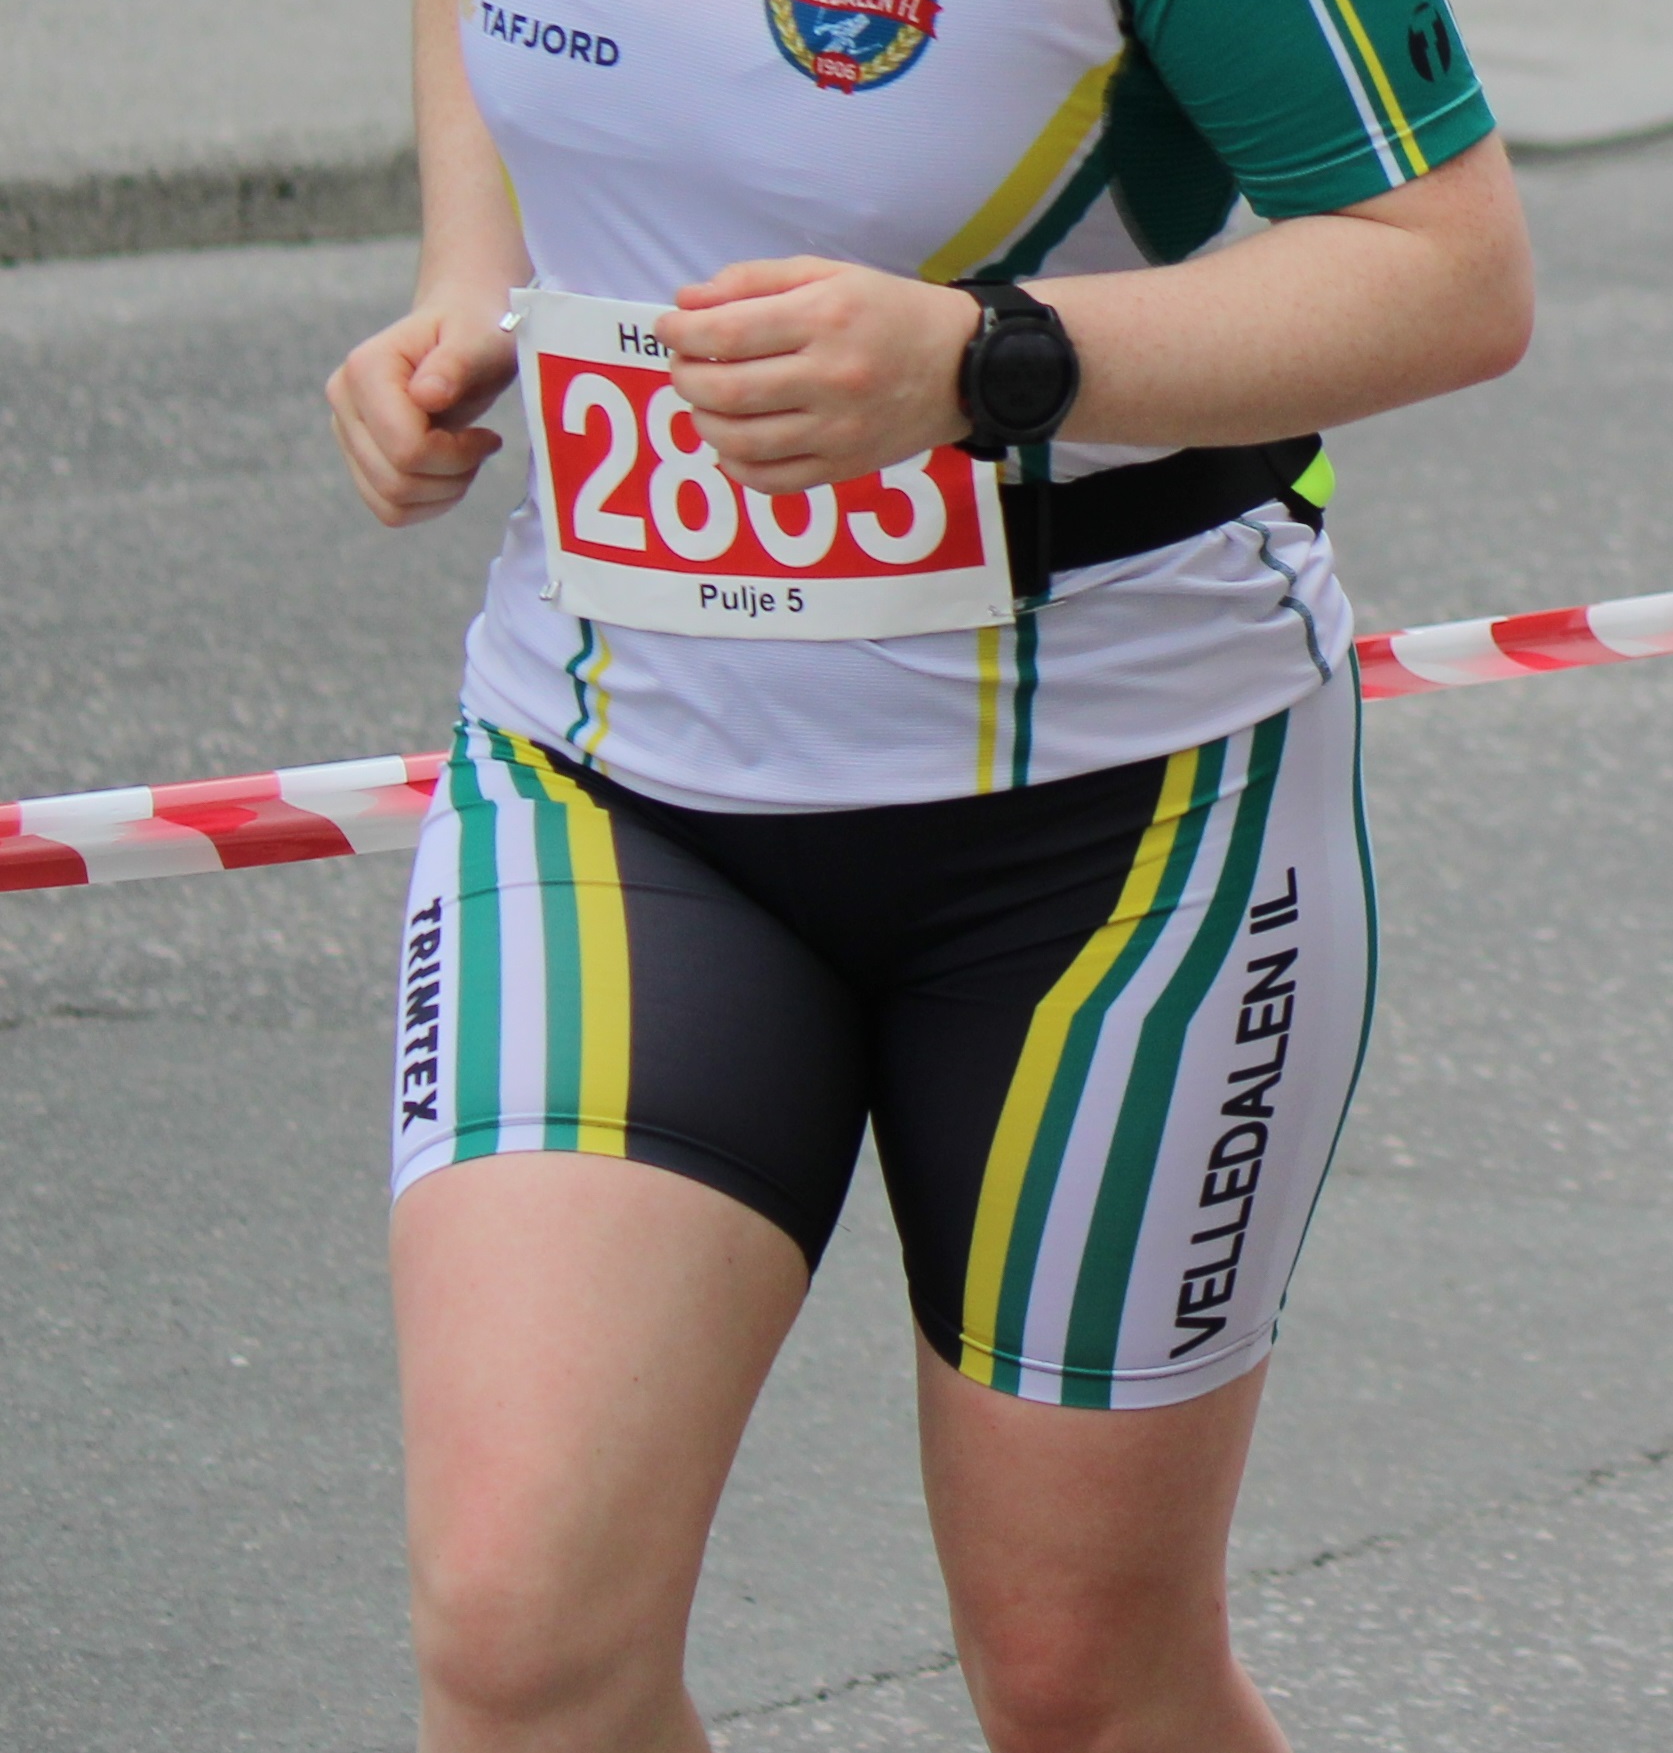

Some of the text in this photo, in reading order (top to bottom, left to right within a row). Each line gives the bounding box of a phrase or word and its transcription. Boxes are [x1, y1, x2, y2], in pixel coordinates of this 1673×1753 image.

[481, 0, 620, 67] TAFJORD
[815, 56, 858, 82] 1906
[699, 583, 804, 618] Pulje 5
[402, 895, 442, 1134] TRIMTEX
[1169, 866, 1299, 1360] VELLEDALEN IL
